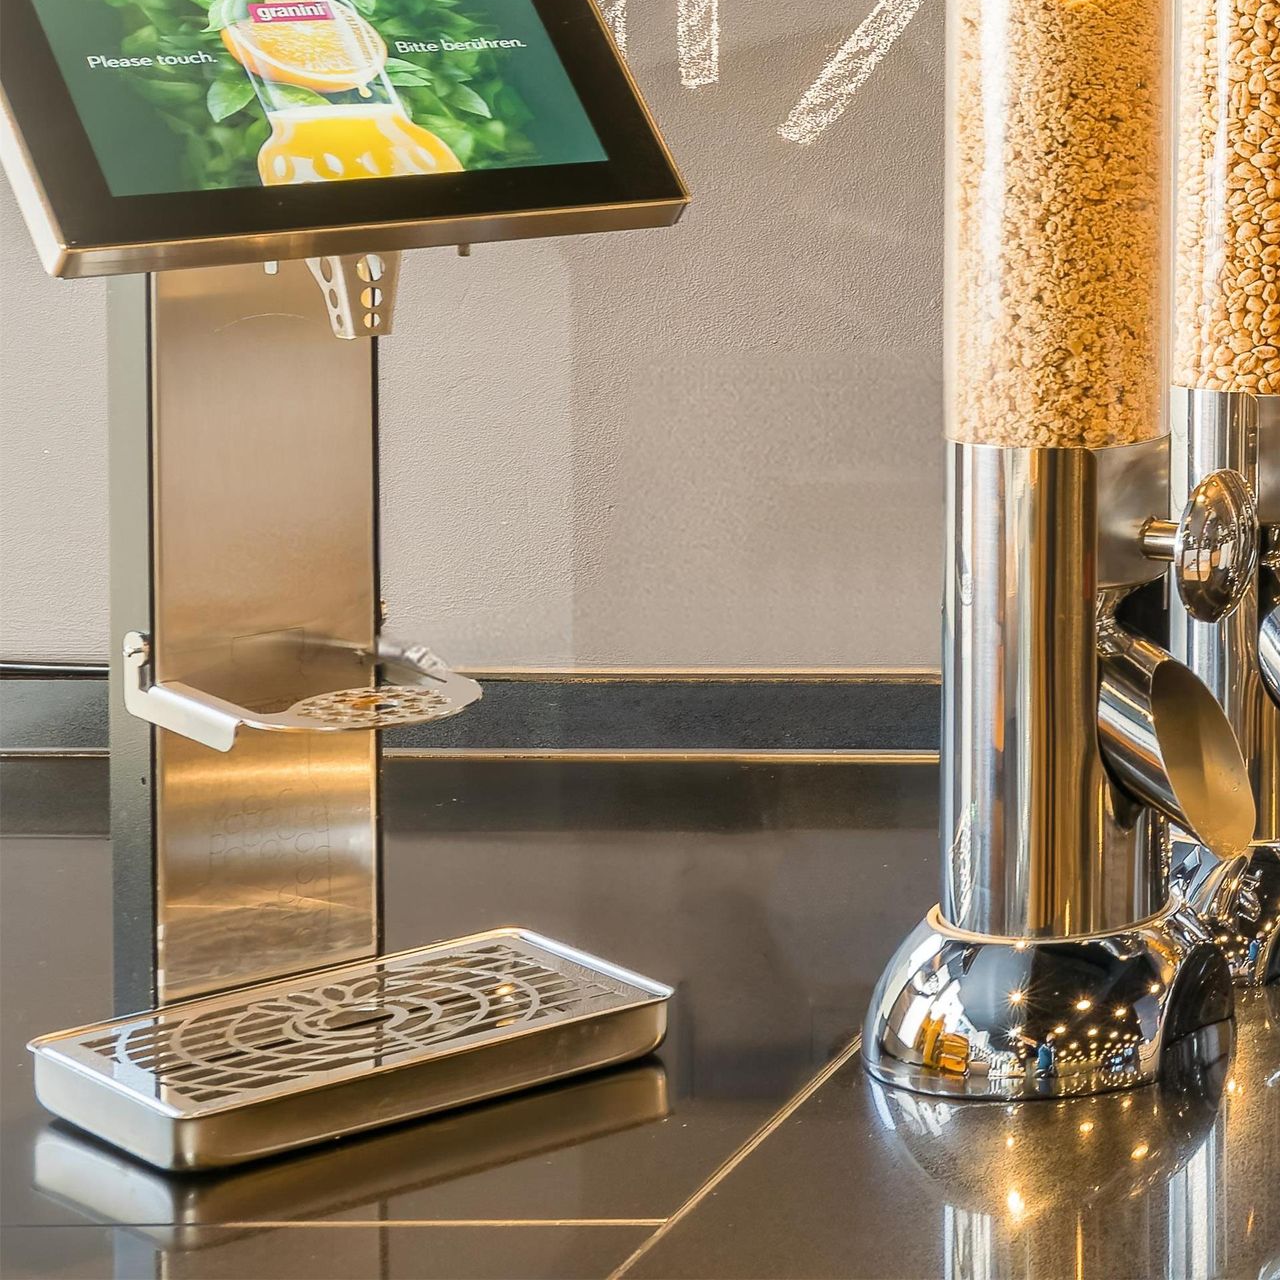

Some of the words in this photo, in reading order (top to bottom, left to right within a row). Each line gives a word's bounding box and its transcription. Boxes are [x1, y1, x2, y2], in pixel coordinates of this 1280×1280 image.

[256, 3, 326, 21] granini
[395, 39, 438, 54] Bitte
[440, 35, 527, 52] berühren.
[87, 54, 153, 69] Please
[156, 50, 218, 65] touch.
